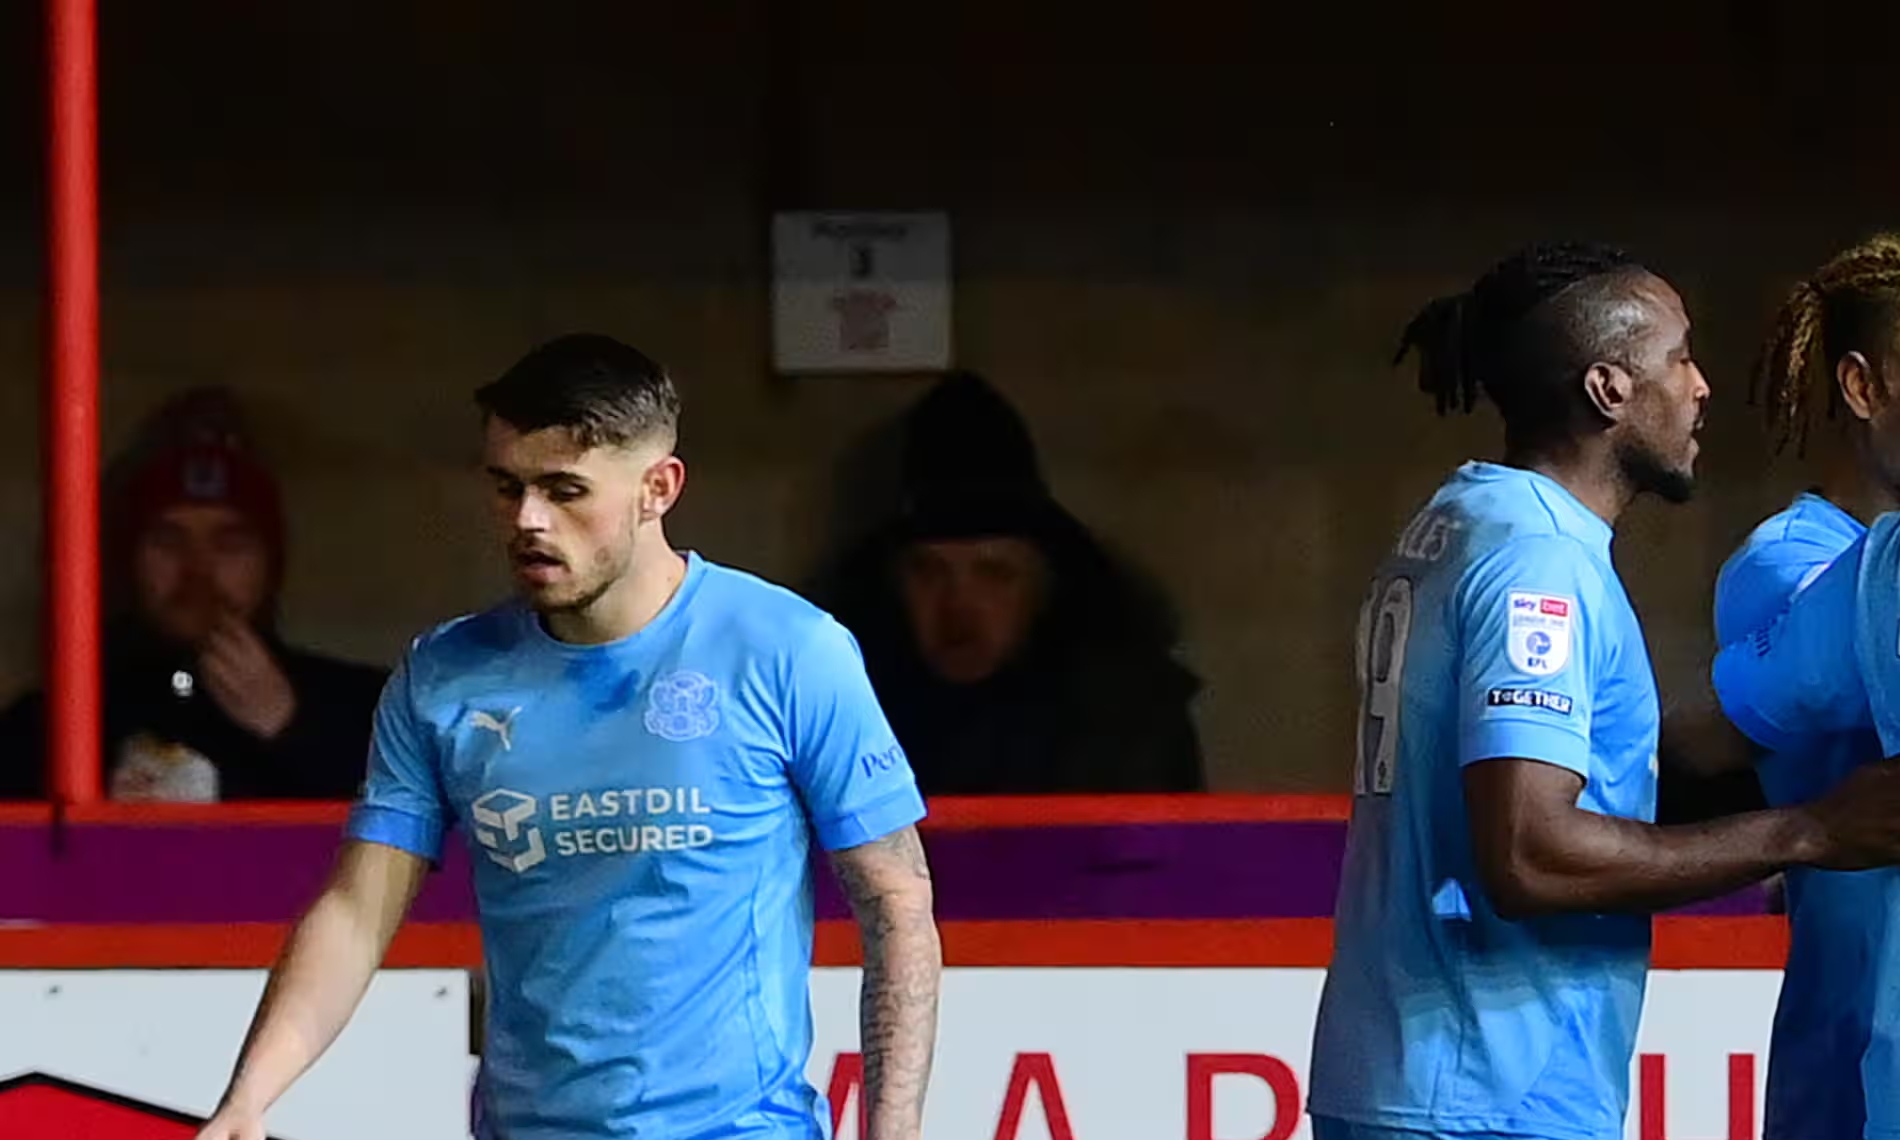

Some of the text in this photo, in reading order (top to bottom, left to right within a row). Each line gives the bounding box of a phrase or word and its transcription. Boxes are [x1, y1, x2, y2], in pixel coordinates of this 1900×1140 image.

[1491, 689, 1571, 714] TOGETHER
[551, 788, 710, 822] EASTDIL
[558, 826, 713, 856] SECURED
